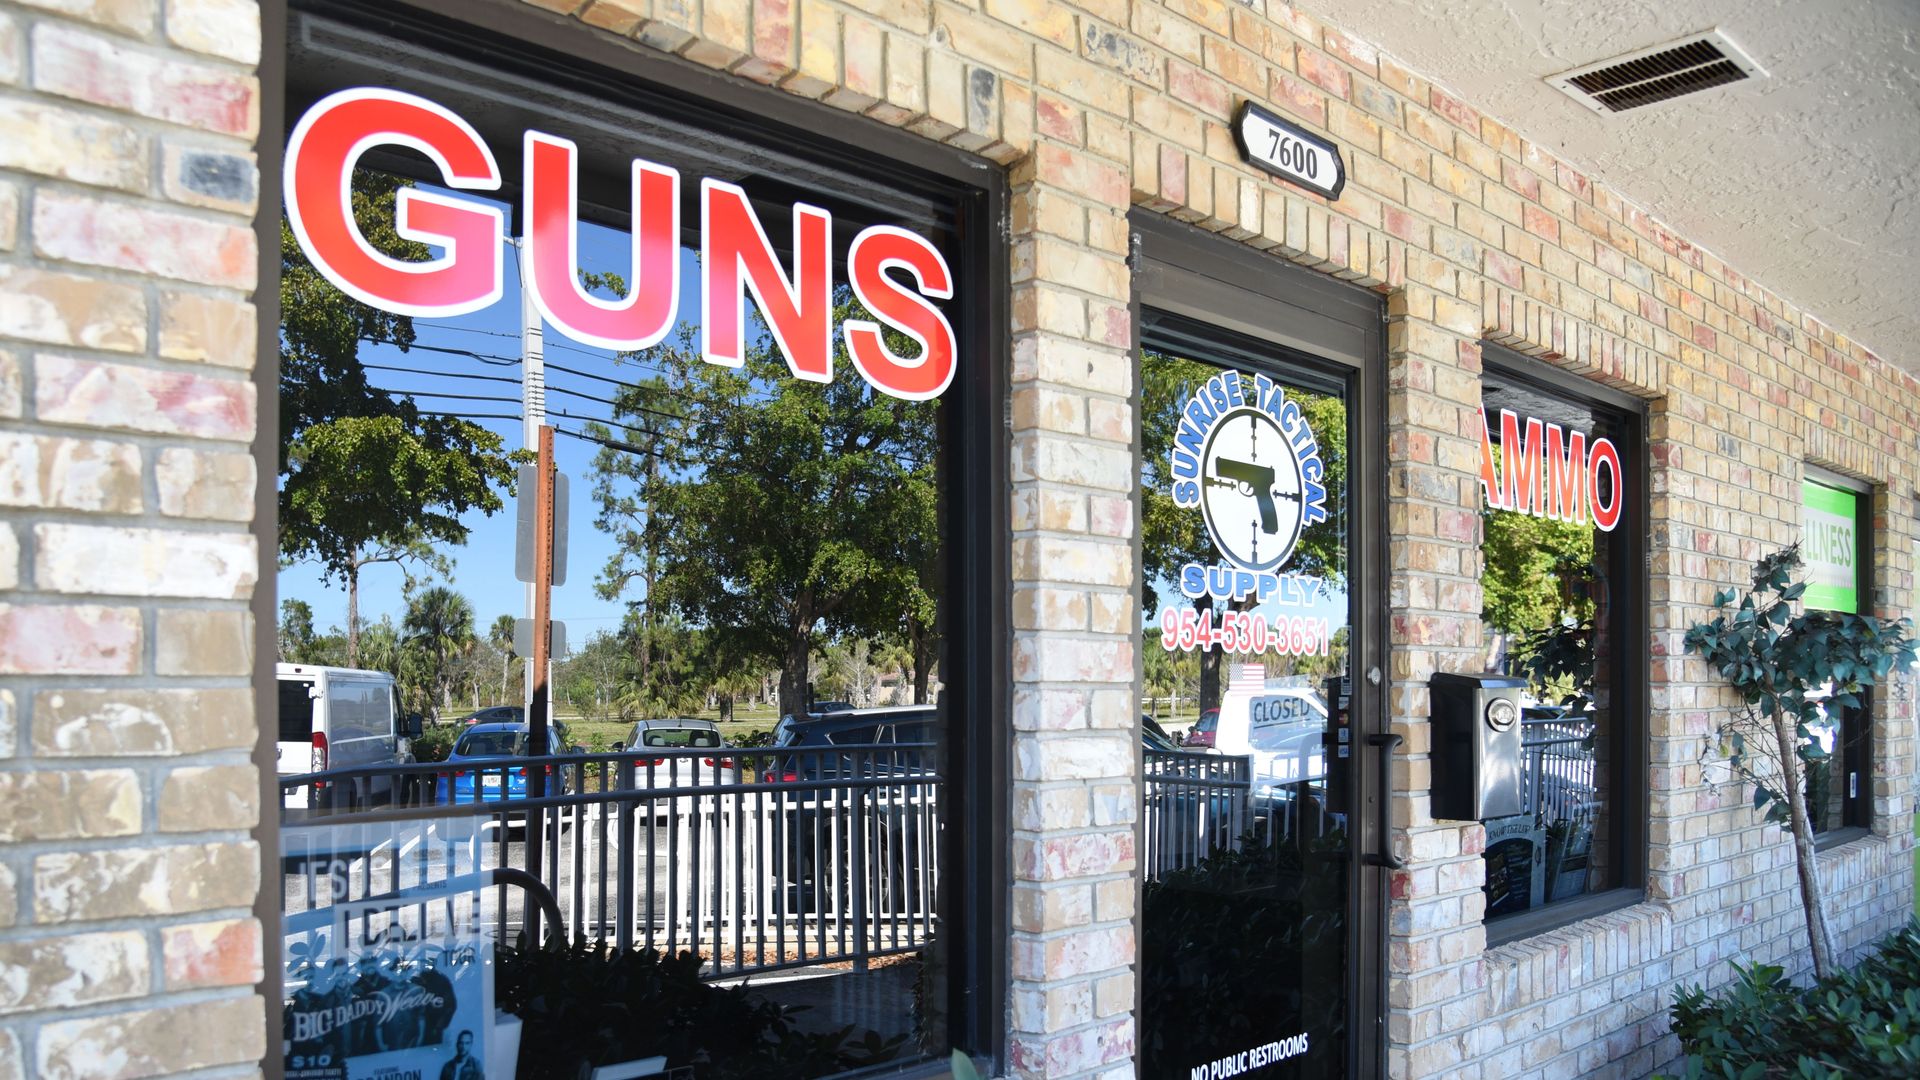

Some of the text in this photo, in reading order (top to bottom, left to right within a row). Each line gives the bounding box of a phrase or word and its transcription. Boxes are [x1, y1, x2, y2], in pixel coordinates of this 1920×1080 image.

[1268, 127, 1318, 180] 7600
[283, 87, 958, 401] GUNS
[1172, 370, 1327, 527] SUNRISE TACTICAL
[1181, 563, 1322, 607] SUPPLY
[1161, 606, 1330, 657] 954-530-3651
[1254, 697, 1310, 723] CLOSED
[293, 1009, 335, 1042] BIG
[335, 1000, 384, 1028] DADDY
[356, 1068, 422, 1080] NDON
[1191, 1031, 1309, 1080] NO PUBLIC RESTROOMS
